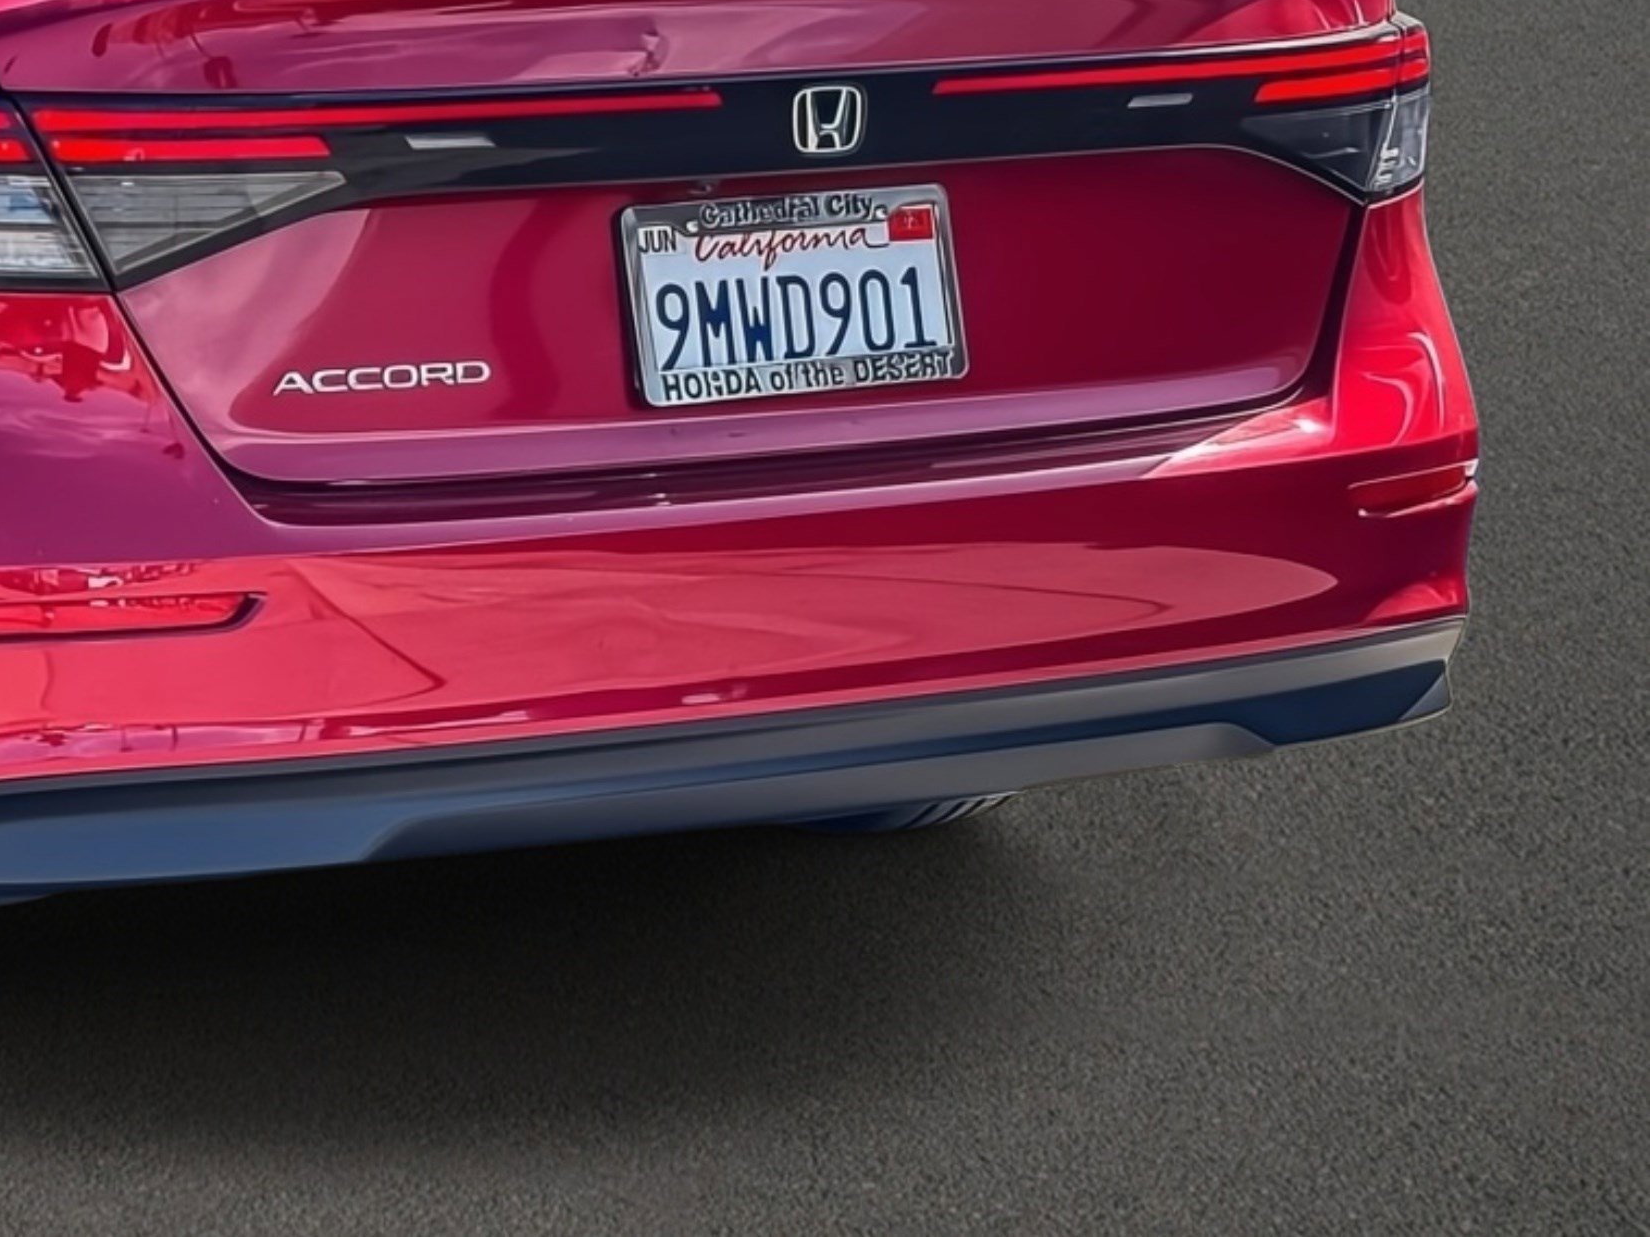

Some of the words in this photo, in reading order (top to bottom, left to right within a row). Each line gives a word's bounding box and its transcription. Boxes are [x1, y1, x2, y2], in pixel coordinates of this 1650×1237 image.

[824, 192, 873, 220] City
[638, 228, 677, 253] JUN
[694, 225, 890, 272] California
[655, 266, 938, 371] 9MWD901
[272, 360, 492, 397] ACCORD
[661, 369, 762, 402] HONDA
[769, 363, 798, 392] of
[803, 362, 845, 388] the
[853, 351, 954, 383] DESERT
